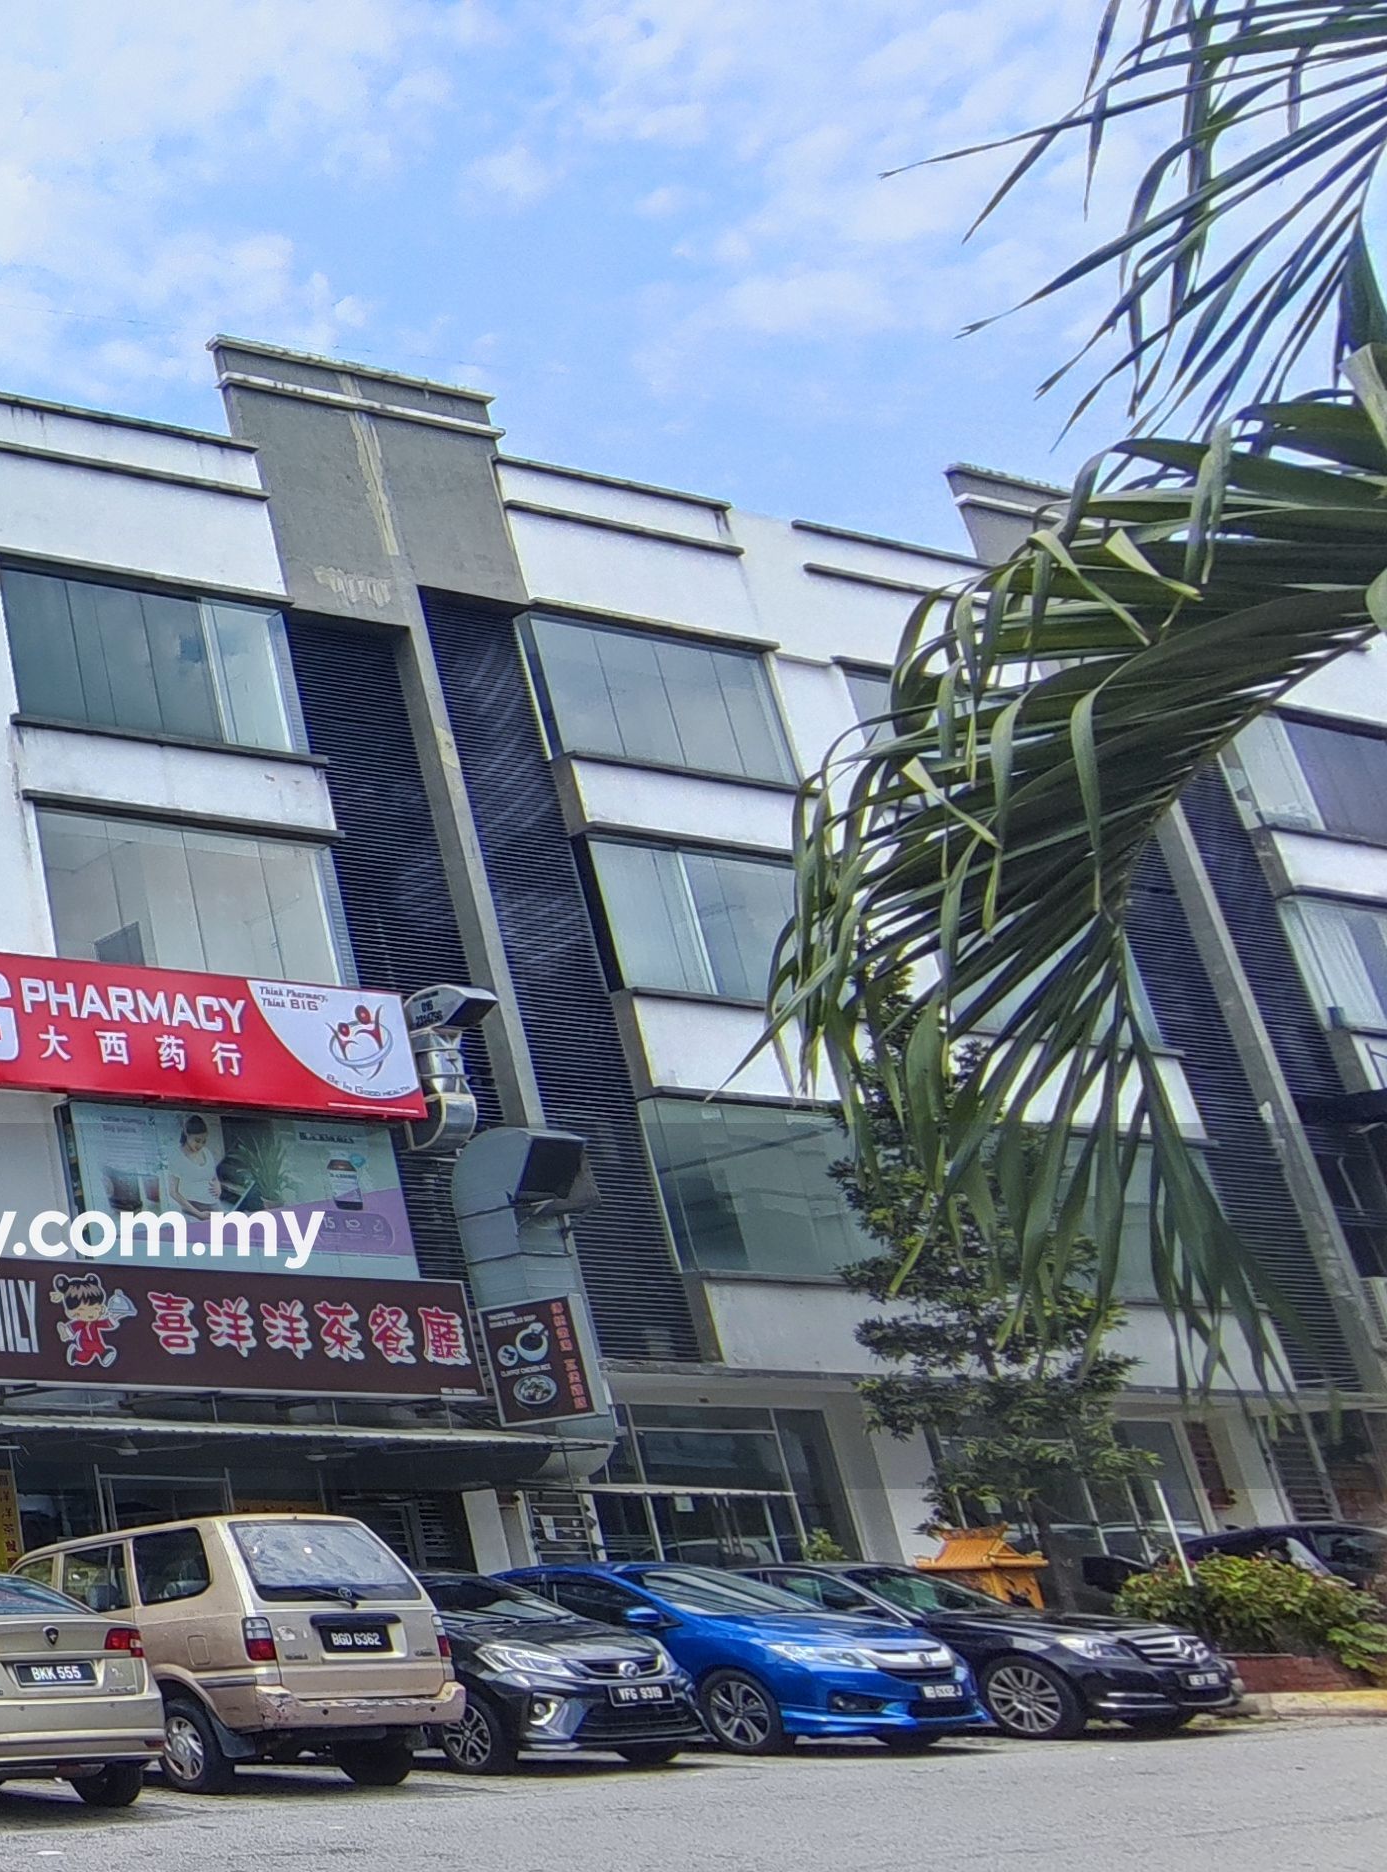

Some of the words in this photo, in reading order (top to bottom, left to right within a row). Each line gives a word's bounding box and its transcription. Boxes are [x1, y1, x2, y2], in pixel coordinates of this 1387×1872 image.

[259, 986, 283, 998] Think
[286, 989, 328, 1003] Pharmacy,
[20, 977, 246, 1034] PHARMACY
[261, 997, 286, 1009] Think
[290, 999, 319, 1012] BIG
[39, 1024, 243, 1077] 大西药行
[148, 1291, 471, 1365] 喜洋洋茶餐廳
[354, 1632, 382, 1646] 6362
[31, 1666, 57, 1681] BKK
[57, 1665, 82, 1680] 555
